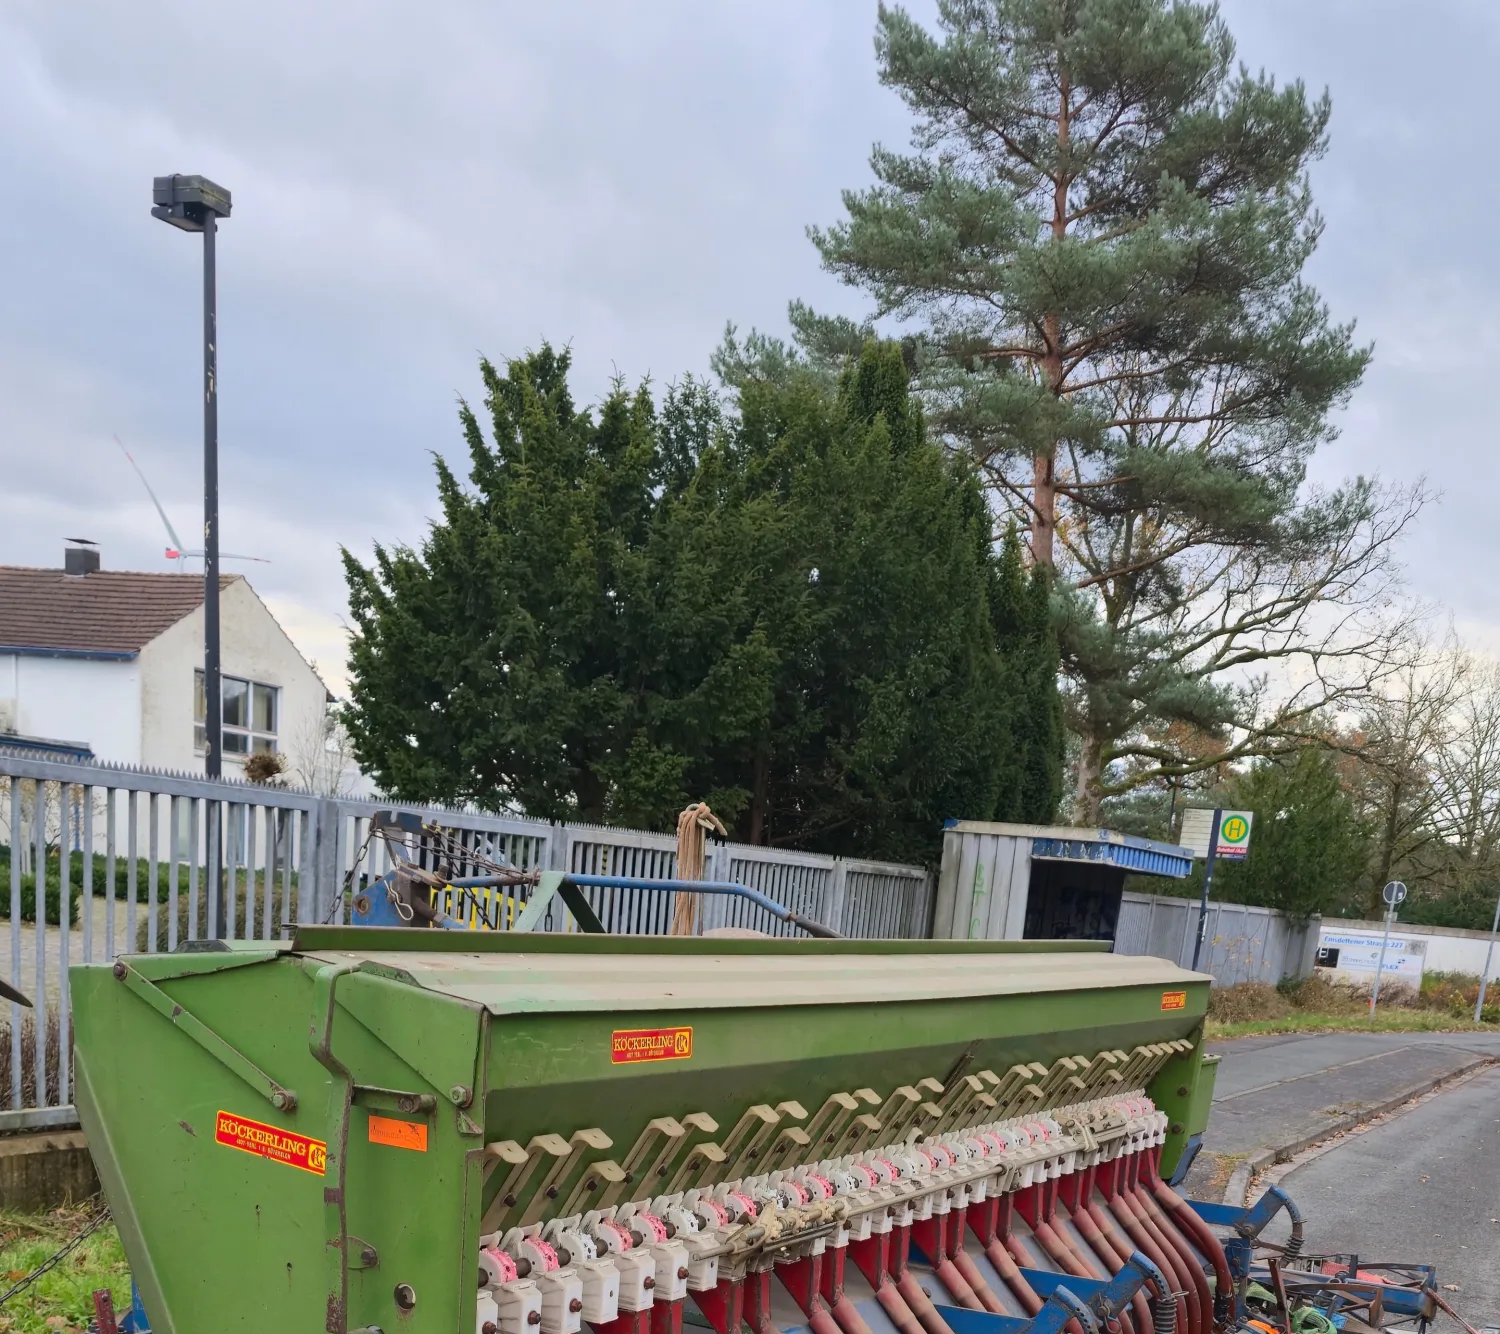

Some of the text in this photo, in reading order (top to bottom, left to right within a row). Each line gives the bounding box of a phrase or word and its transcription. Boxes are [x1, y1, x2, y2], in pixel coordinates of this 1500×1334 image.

[1228, 820, 1242, 837] H
[1366, 939, 1390, 948] Strase
[613, 1035, 674, 1051] KÖCKERLING
[219, 1118, 306, 1157] KÖCKERLING
